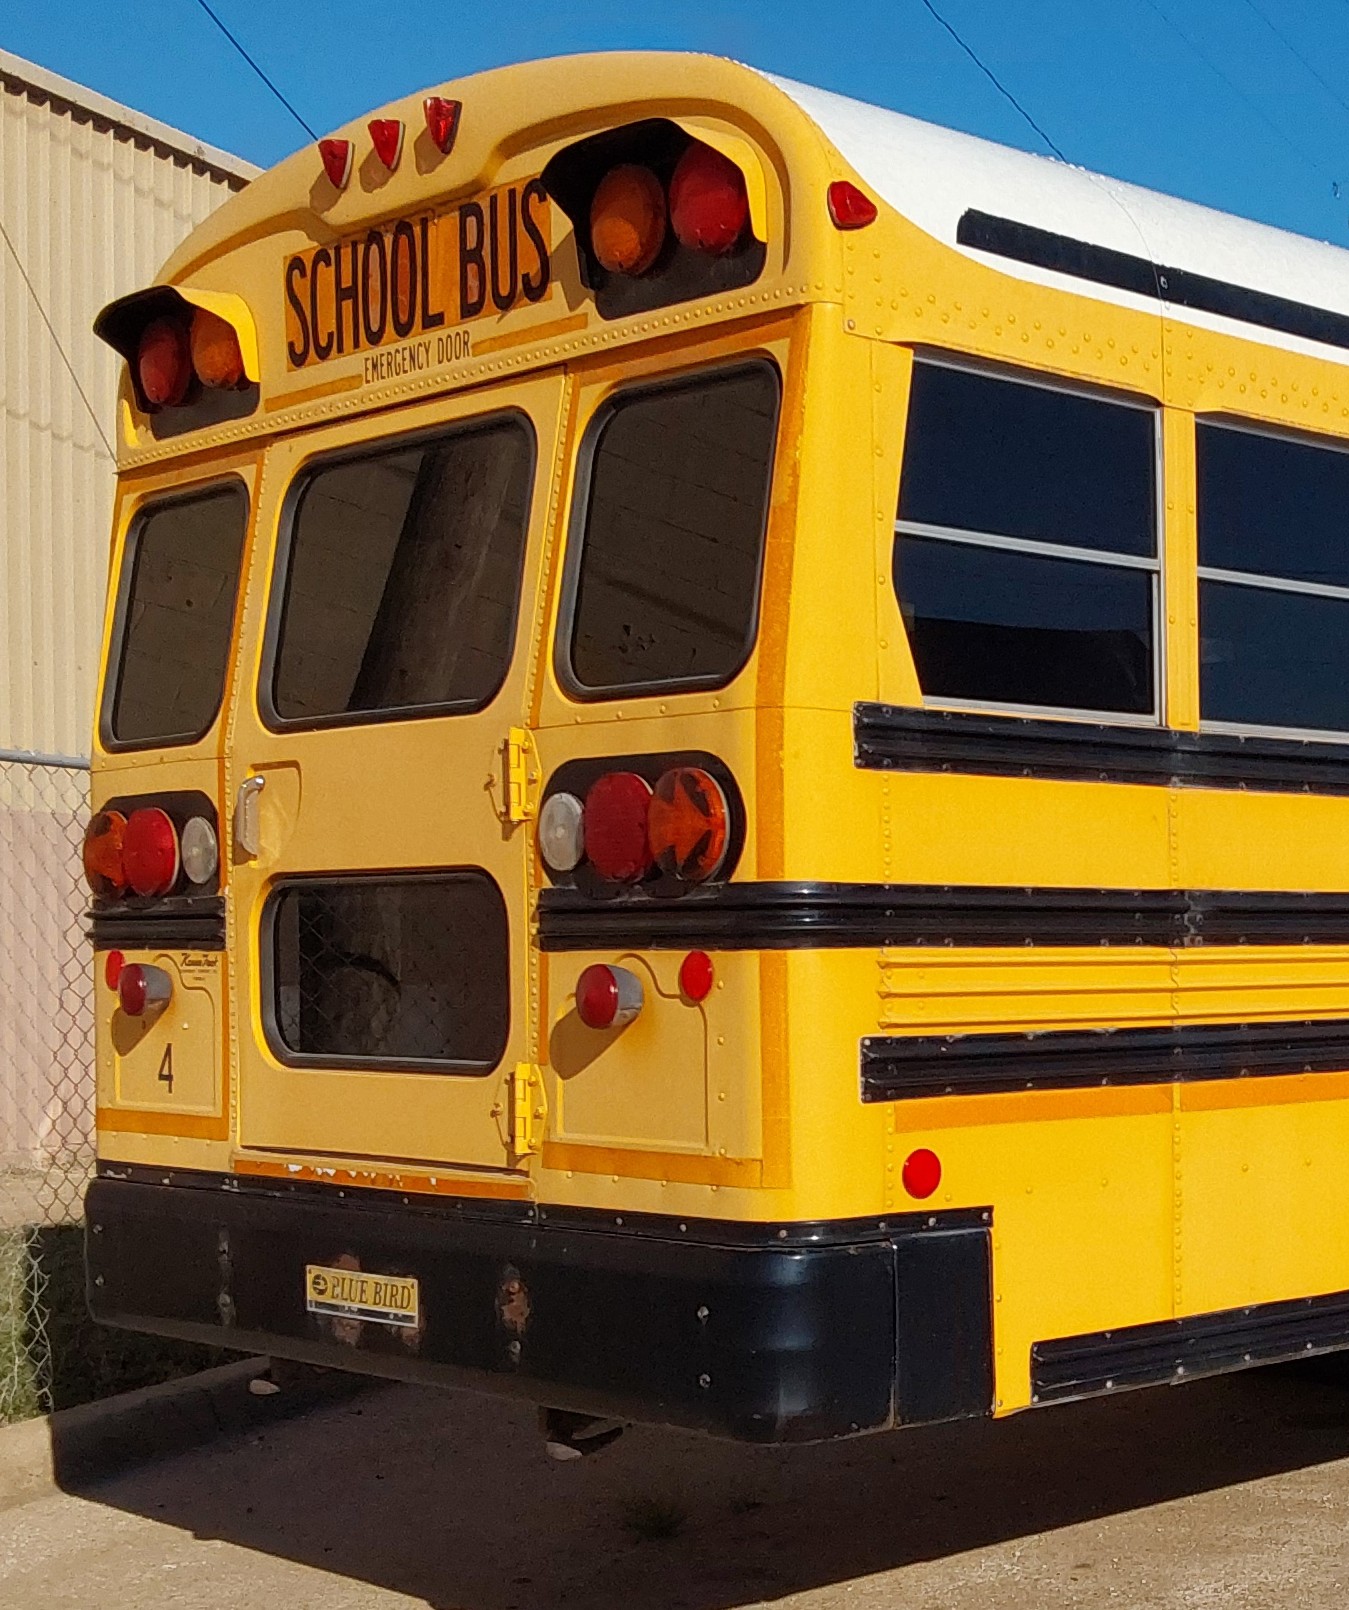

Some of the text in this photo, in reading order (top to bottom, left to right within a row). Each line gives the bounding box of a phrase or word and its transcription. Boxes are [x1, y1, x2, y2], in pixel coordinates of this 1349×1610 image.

[285, 178, 550, 368] SCHOOL BUS
[364, 330, 471, 384] EMERGENCY DOOR
[158, 1042, 174, 1094] 4
[331, 1276, 411, 1309] BLUE BIRD
